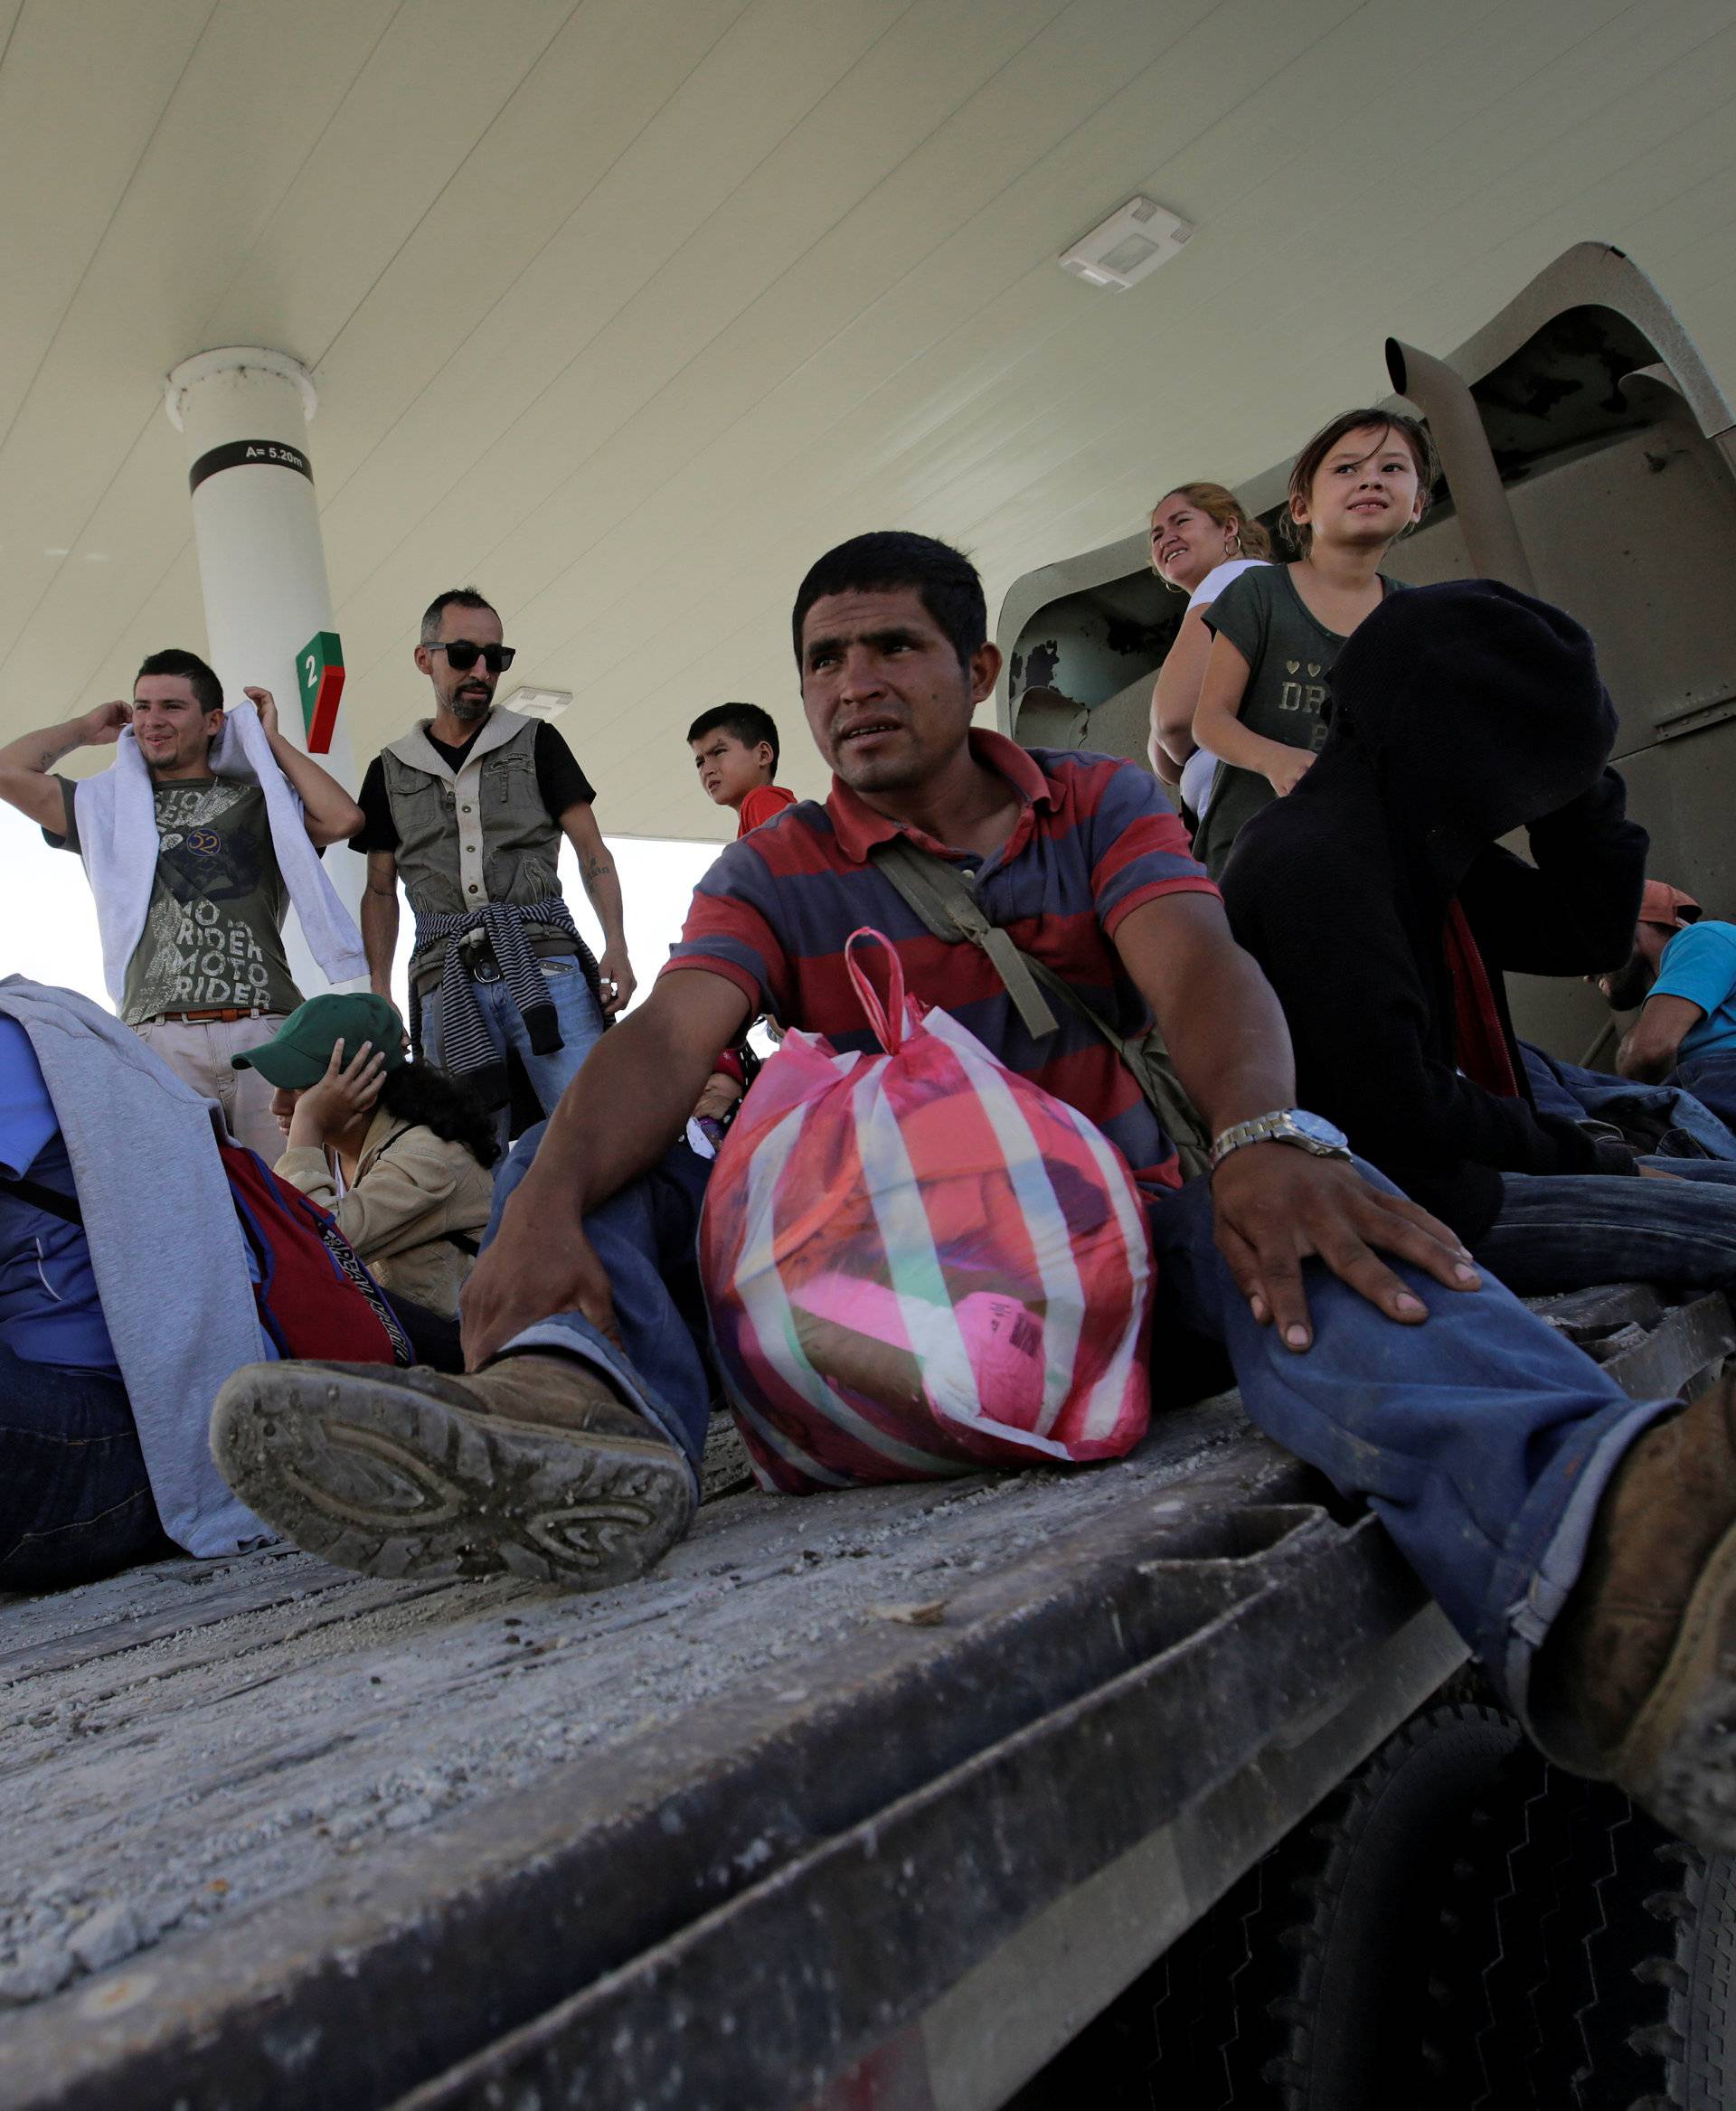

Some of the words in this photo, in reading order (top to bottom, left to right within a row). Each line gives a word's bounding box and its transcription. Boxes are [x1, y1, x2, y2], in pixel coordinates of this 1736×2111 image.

[269, 448, 303, 468] 5.20m
[306, 655, 318, 688] 2
[189, 831, 218, 855] 52
[174, 949, 269, 988] MOTO
[170, 975, 272, 1011] RIDER
